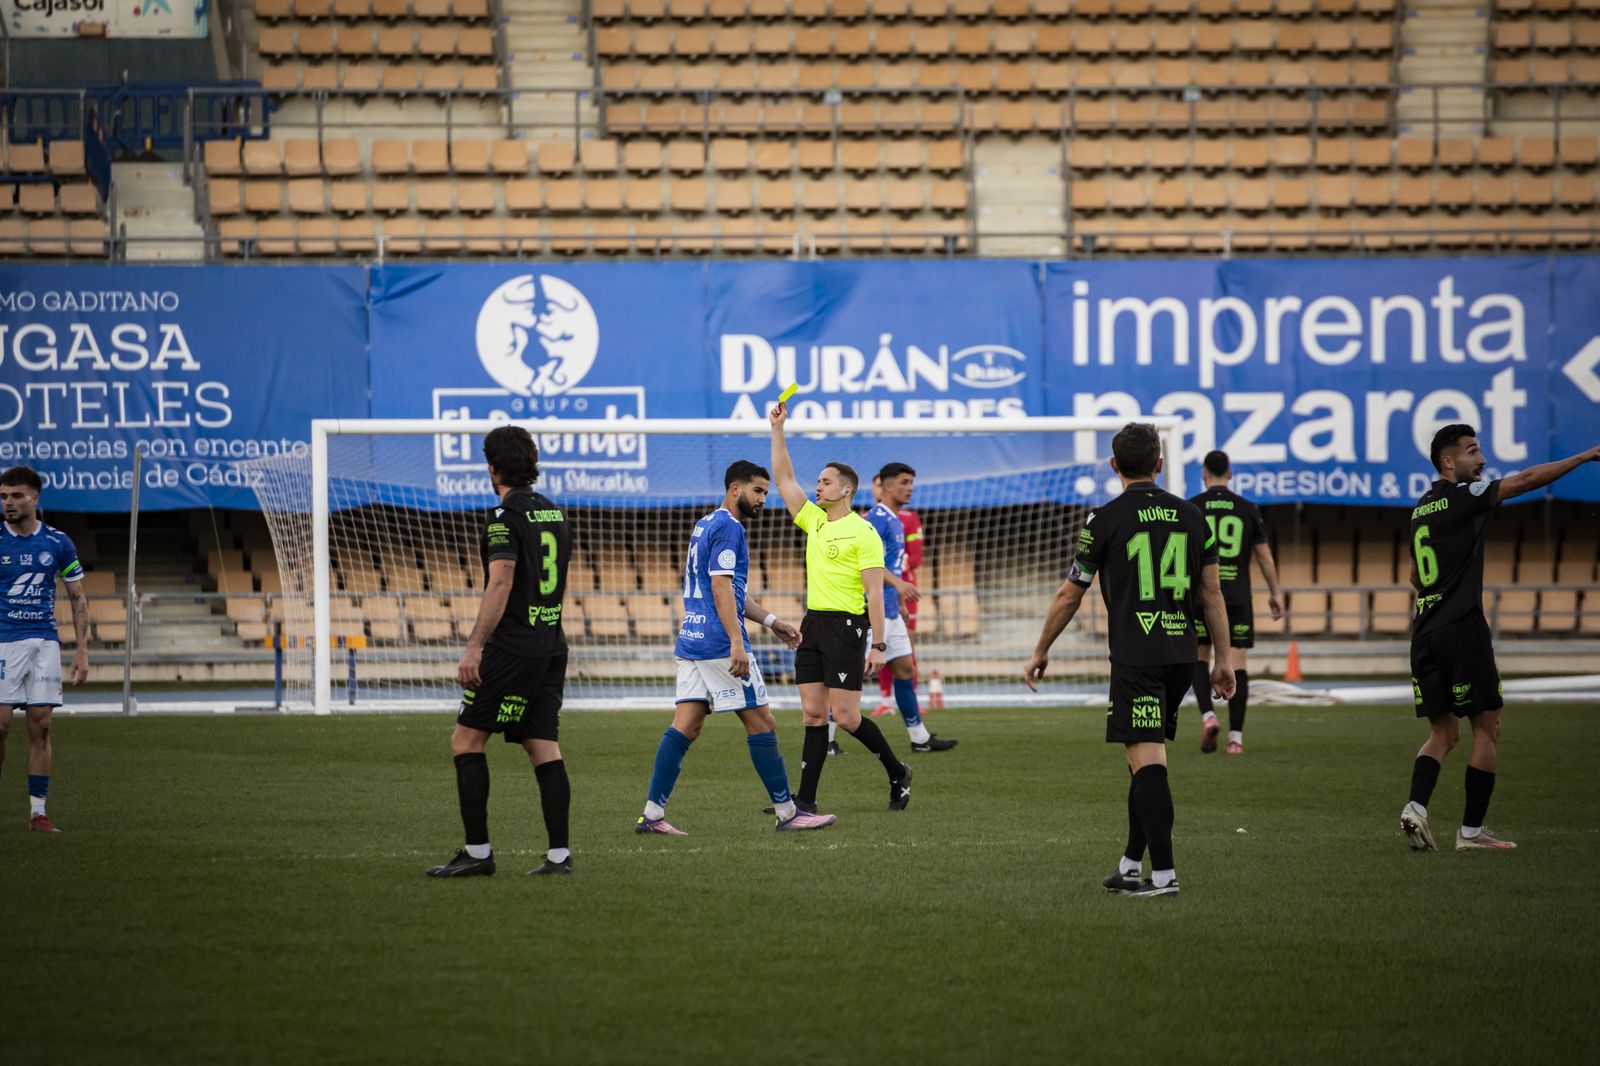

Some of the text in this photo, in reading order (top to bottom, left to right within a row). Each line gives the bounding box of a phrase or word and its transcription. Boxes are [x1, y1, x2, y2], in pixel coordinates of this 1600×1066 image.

[43, 291, 179, 312] GADITANO
[1073, 274, 1527, 388] imprenta
[0, 323, 200, 371] GASA
[720, 333, 949, 393] DURÁN
[511, 398, 588, 411] GRUPO
[136, 437, 188, 458] con
[195, 437, 309, 459] encanto
[441, 406, 471, 461] El
[146, 464, 179, 488] de
[186, 462, 265, 488] Cádiz
[1228, 467, 1371, 498] PRESIÓN
[1378, 472, 1401, 498] &
[1138, 505, 1179, 522] NÚÑEZ
[540, 530, 558, 595] 3
[1126, 531, 1191, 601] 14
[1414, 524, 1439, 587] 6
[1132, 704, 1160, 719] sea
[1132, 719, 1161, 728] FOODS
